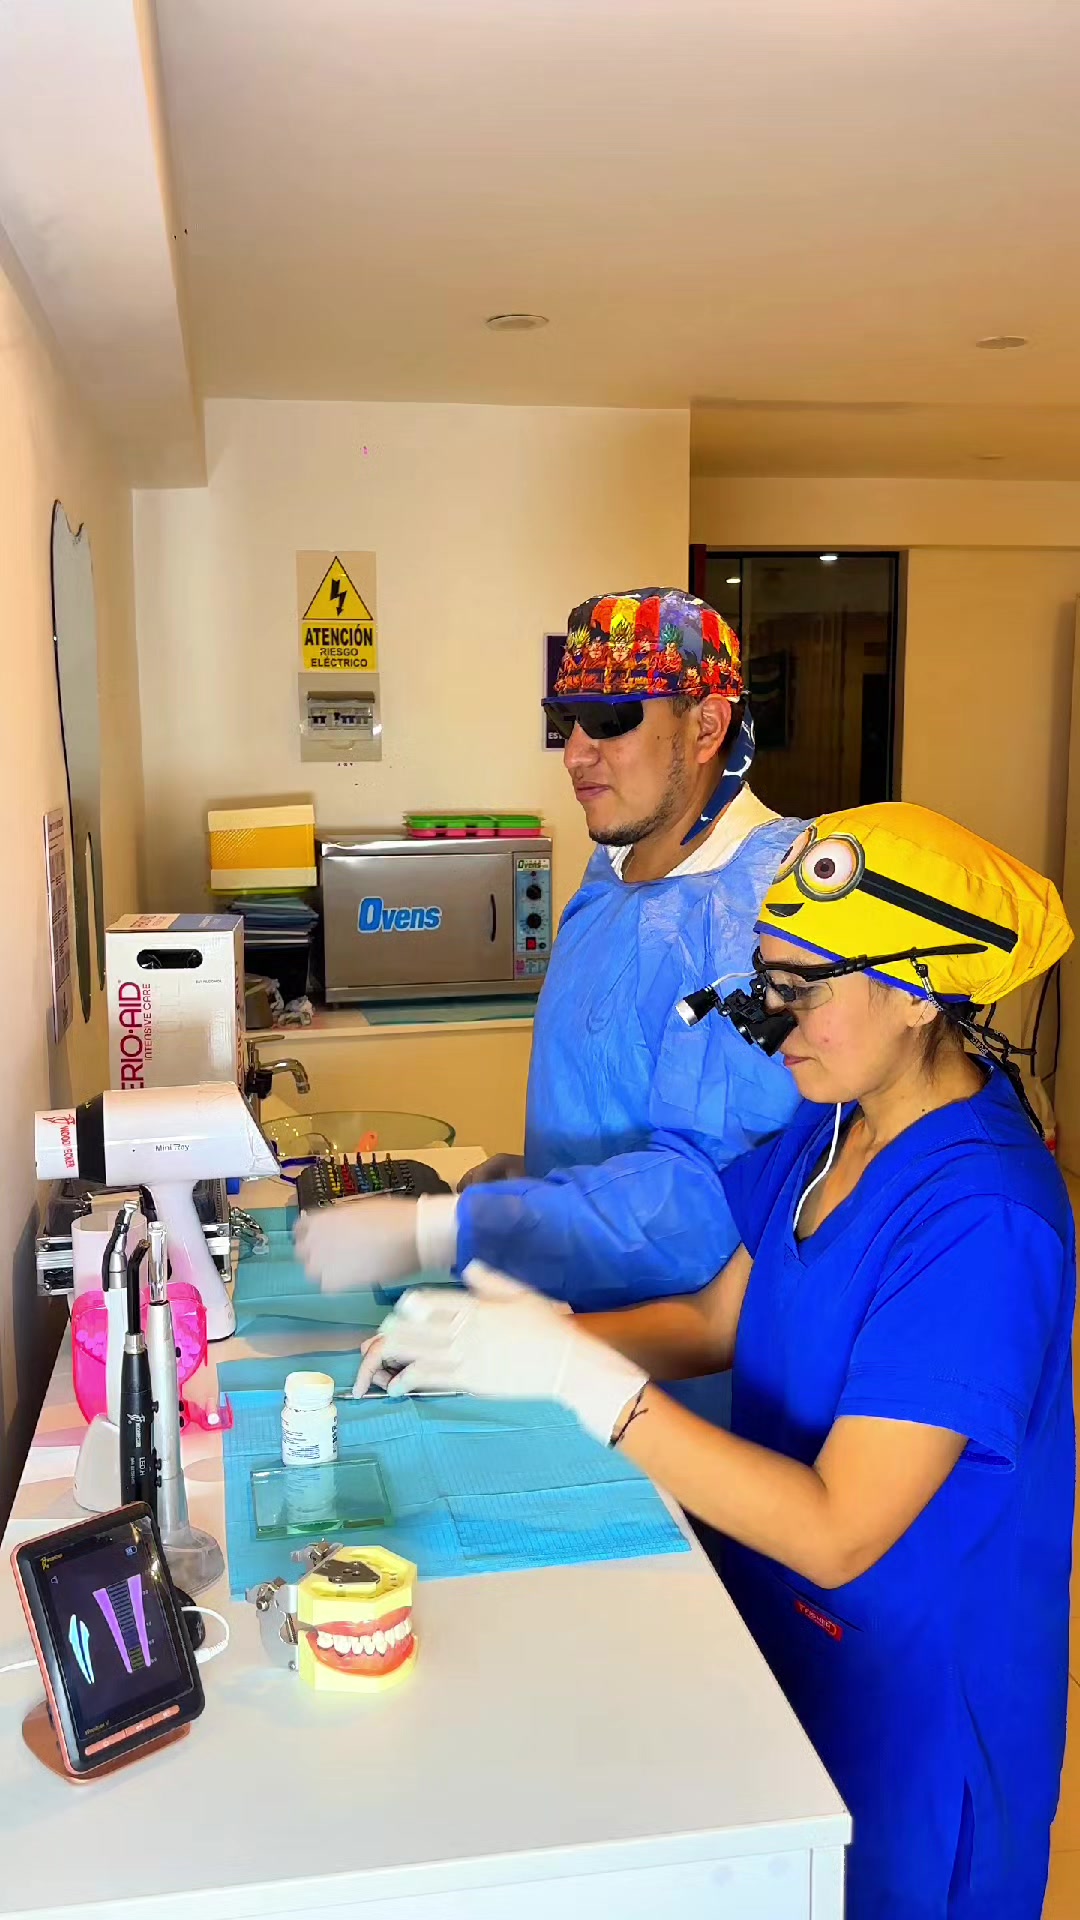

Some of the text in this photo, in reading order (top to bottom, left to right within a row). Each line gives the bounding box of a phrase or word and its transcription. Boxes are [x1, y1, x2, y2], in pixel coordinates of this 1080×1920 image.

[304, 624, 373, 646] ATENCIÓN
[311, 657, 368, 668] ELÉCTRICO
[320, 648, 358, 656] RIESGO
[358, 896, 441, 932] Ovens
[142, 983, 152, 1061] INTENSIVE CARE
[60, 1125, 75, 1168] WOODECKER
